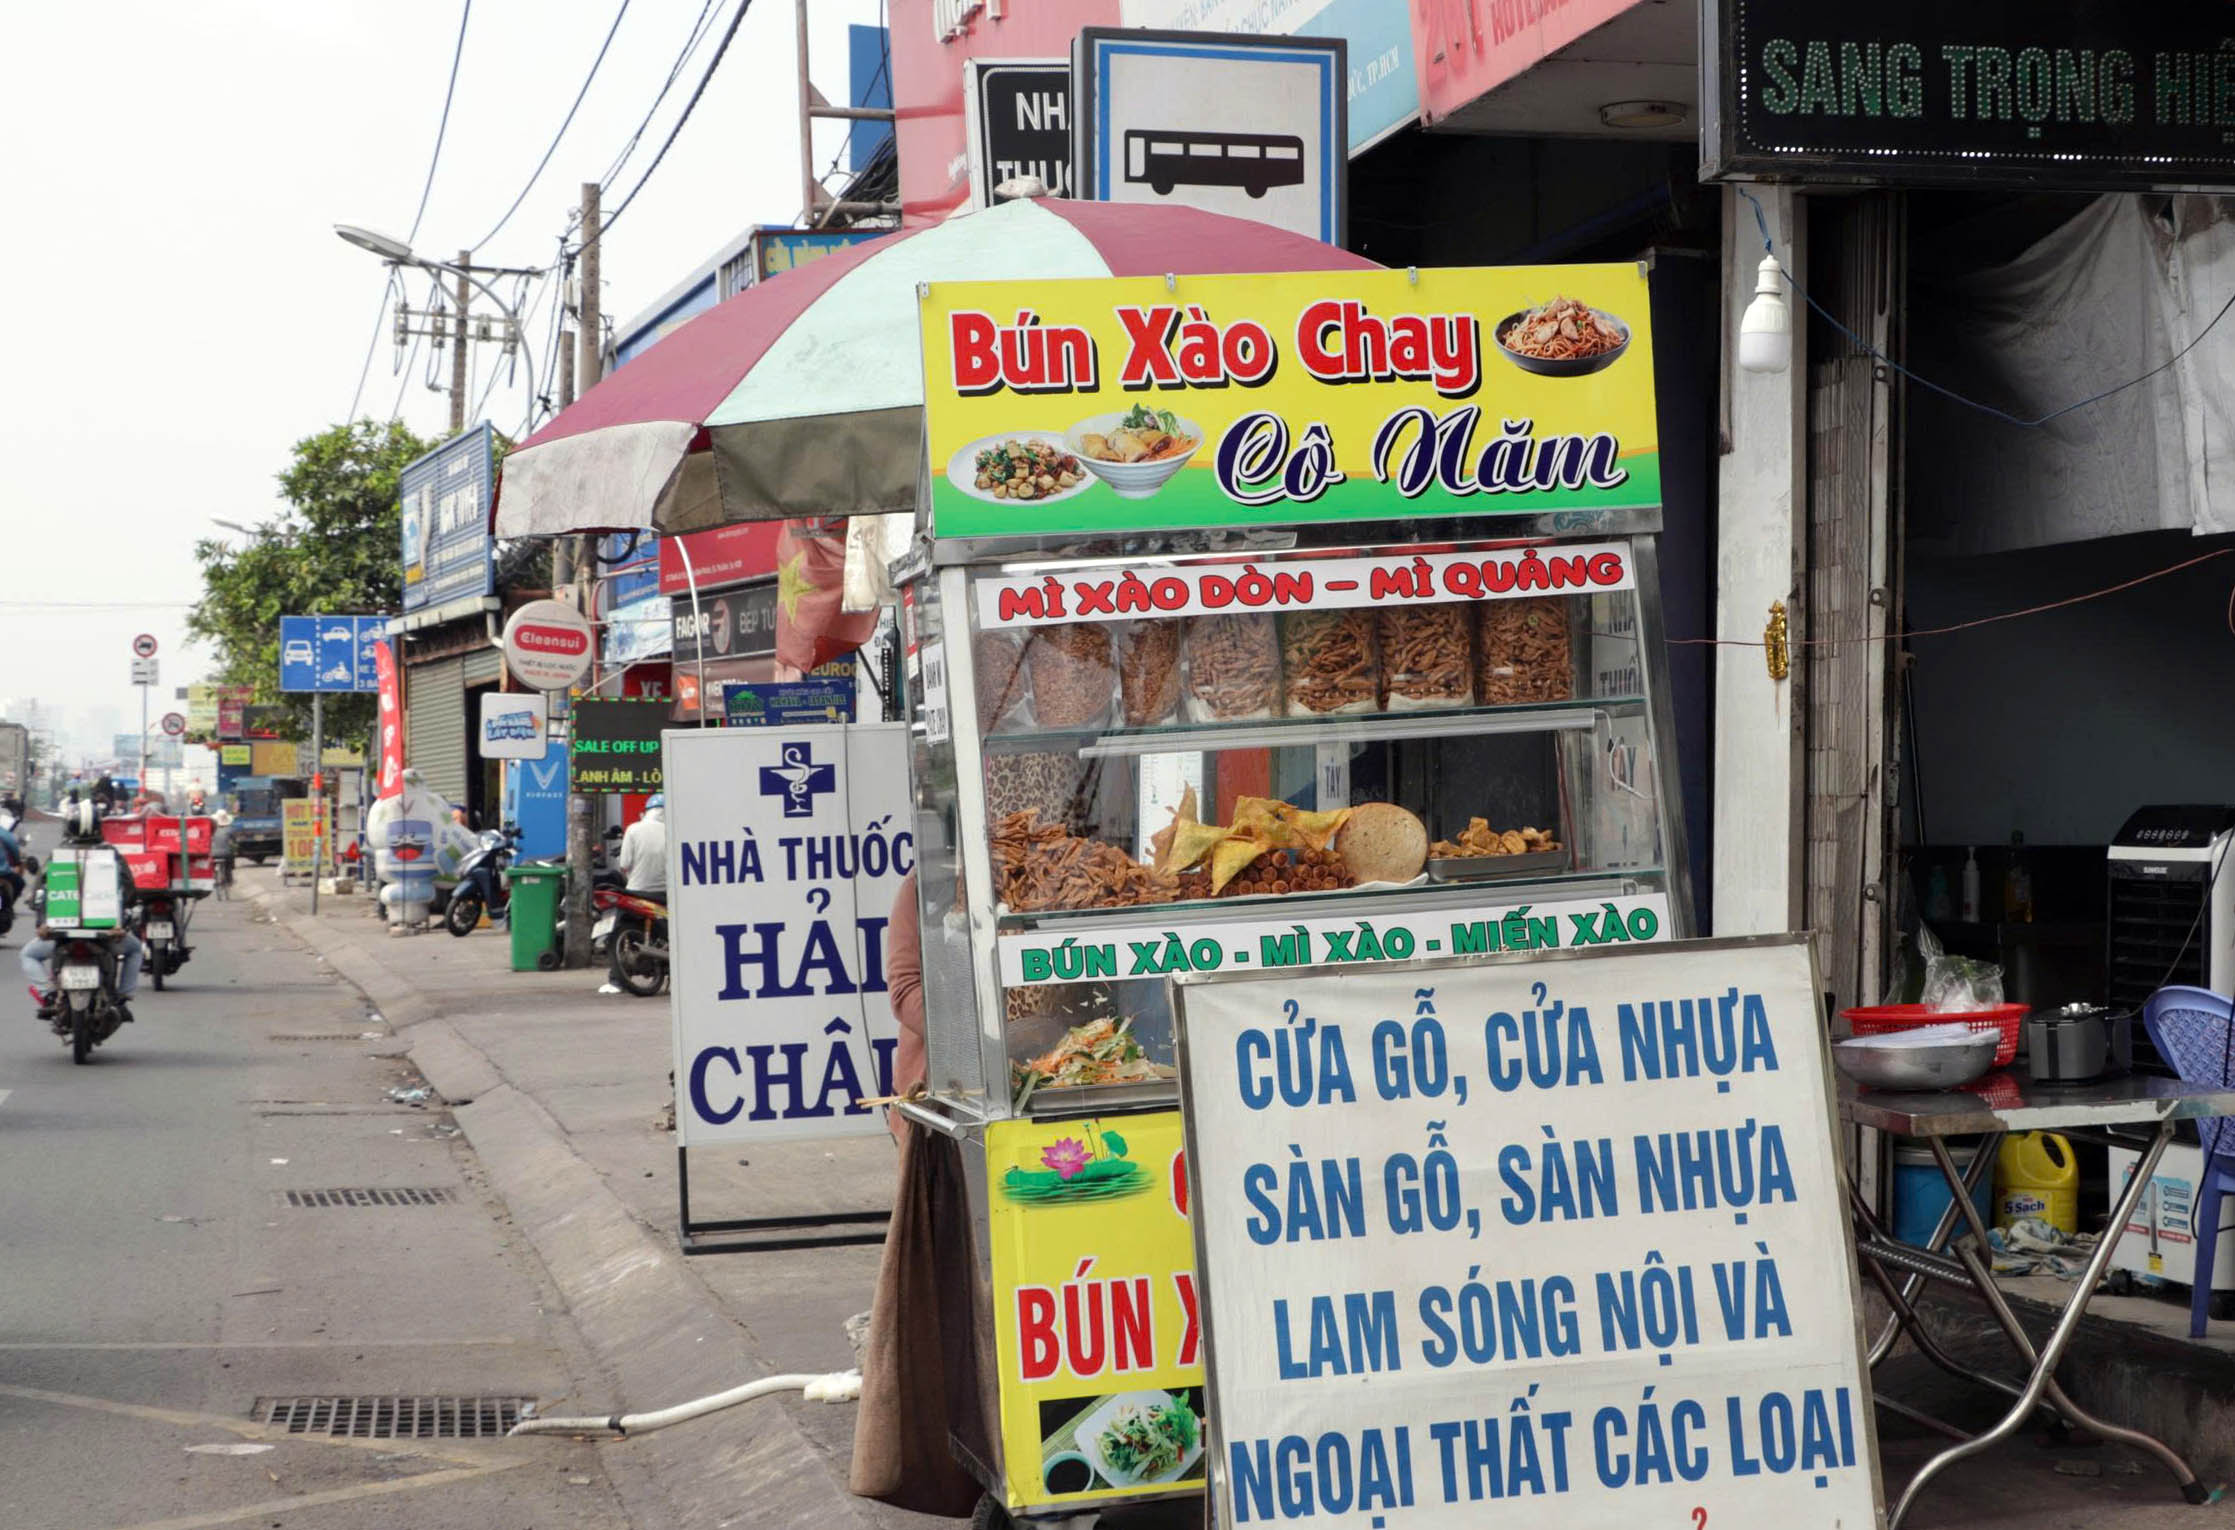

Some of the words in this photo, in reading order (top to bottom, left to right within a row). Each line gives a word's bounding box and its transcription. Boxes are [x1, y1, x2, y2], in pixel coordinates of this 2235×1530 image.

[1015, 92, 1071, 131] NH
[1761, 38, 1923, 118] SANG
[1941, 45, 2135, 139] TRỌNG
[948, 309, 1099, 396] Bún
[1116, 304, 1279, 391] Xào
[1296, 299, 1483, 398] Chay
[1214, 408, 1344, 503] Cô
[1372, 404, 1629, 498] Năm
[999, 576, 1065, 621] MÌ
[1076, 570, 1189, 616] XÀO
[1199, 565, 1314, 609] DÒN
[1370, 556, 1437, 598] MÌ
[1442, 548, 1625, 595] QUẢNG
[575, 740, 609, 753] SALE
[612, 740, 637, 753] OFF
[640, 740, 659, 753] UP
[680, 826, 765, 886] NHÀ
[778, 815, 915, 883] THUỐC
[715, 887, 889, 1001] HẢI
[1021, 937, 1118, 982] BÚN
[1129, 932, 1223, 977] XÀO
[1261, 926, 1312, 967] MÌ
[1323, 922, 1415, 963] XÀO
[1451, 906, 1559, 957] MIẾN
[1569, 905, 1660, 946] XÀO
[1235, 1000, 1357, 1111] CỬA
[1371, 988, 1468, 1107] GỖ,
[1484, 981, 1604, 1093] CỬA
[1617, 987, 1780, 1095] NHỰA
[1243, 1145, 1367, 1246] SÀN
[1383, 1120, 1482, 1240] GỖ,
[1497, 1125, 1623, 1226] SÀN
[1634, 1118, 1798, 1225] NHỰA
[1017, 1256, 1155, 1382] BÚN
[1273, 1290, 1401, 1381] LAM
[1418, 1265, 1581, 1368] SÓNG
[1594, 1250, 1698, 1366] NỘI
[1711, 1241, 1793, 1342] VÀ
[1229, 1426, 1414, 1529] NGOẠI
[1429, 1383, 1573, 1503] THẤT
[1592, 1386, 1710, 1490] CÁC
[1724, 1387, 1857, 1489] LOẠI
